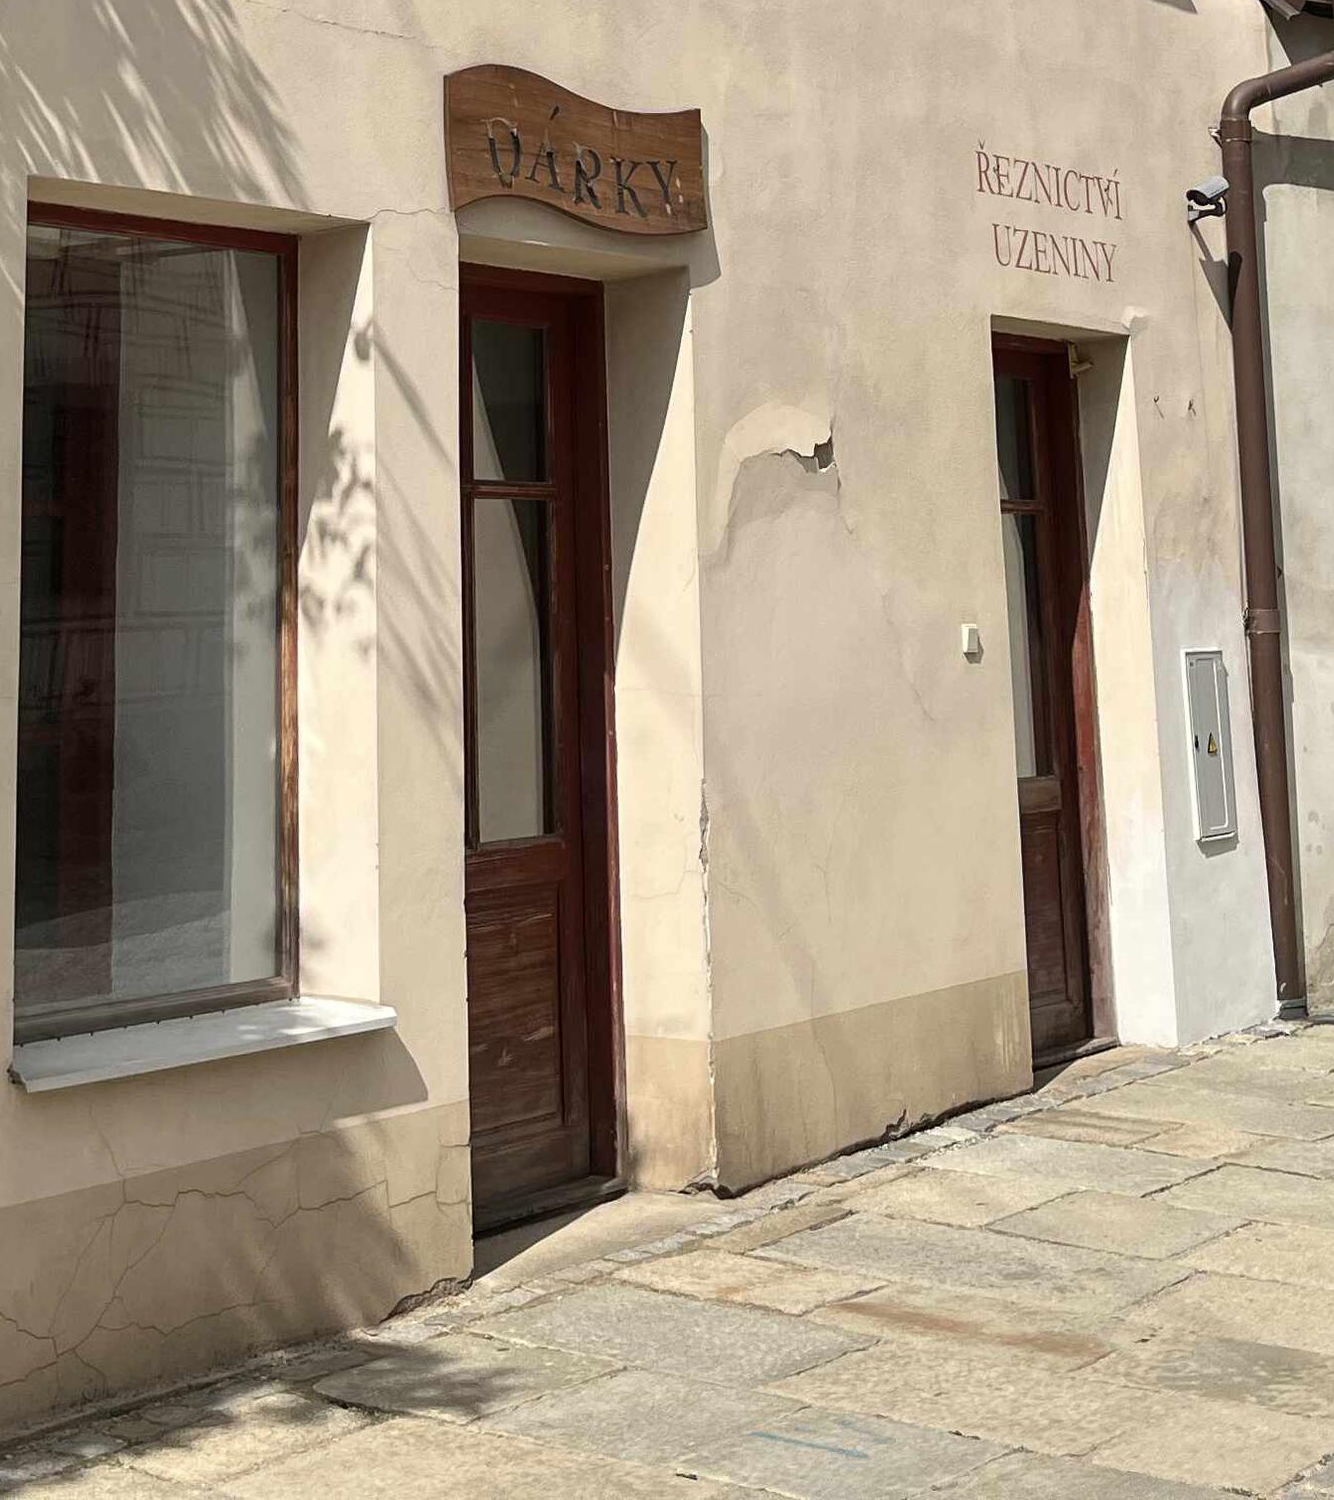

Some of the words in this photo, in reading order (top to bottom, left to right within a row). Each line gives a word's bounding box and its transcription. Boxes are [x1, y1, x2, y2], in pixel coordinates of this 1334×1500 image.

[481, 105, 677, 218] DÁRKY
[975, 138, 1123, 220] ŘEZNICTVÍ
[992, 223, 1116, 282] UZENINY
